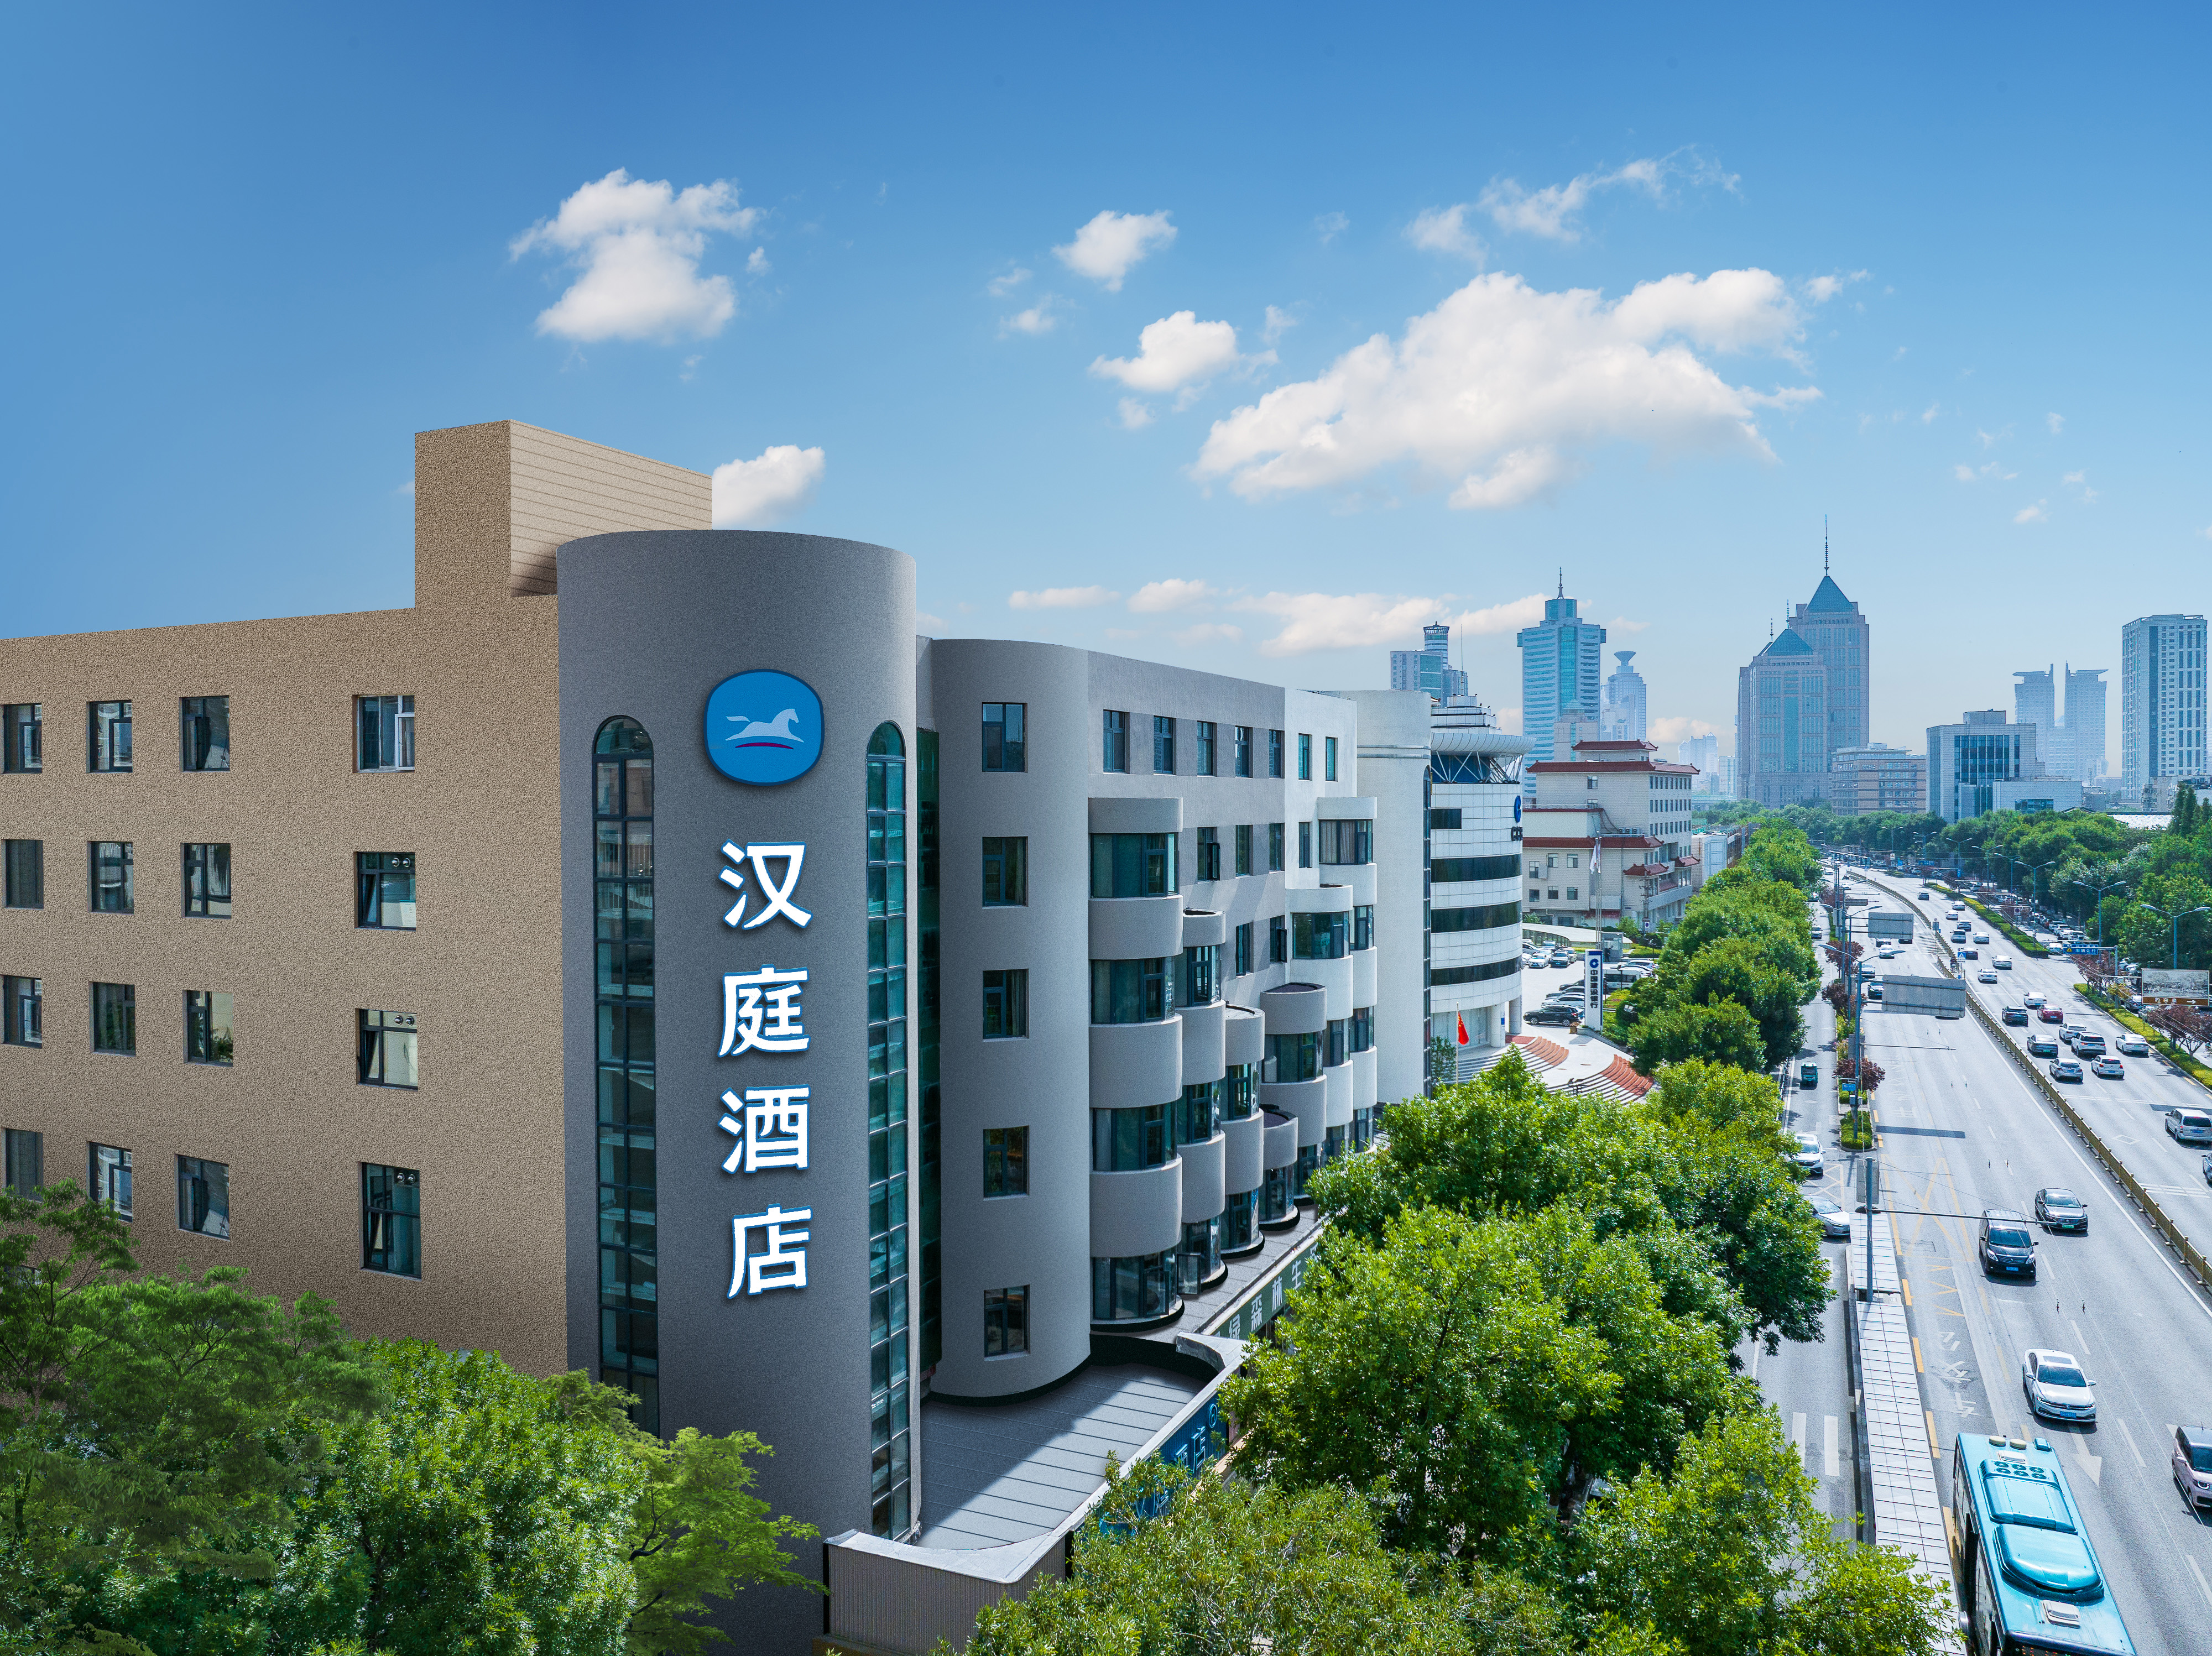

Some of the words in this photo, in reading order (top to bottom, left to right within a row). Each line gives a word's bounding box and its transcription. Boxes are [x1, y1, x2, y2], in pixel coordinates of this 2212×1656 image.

[1590, 970, 1599, 1009] 中国建设银行
[718, 838, 813, 1299] 汉庭酒店
[1215, 1242, 1320, 1340] 绿森林生
